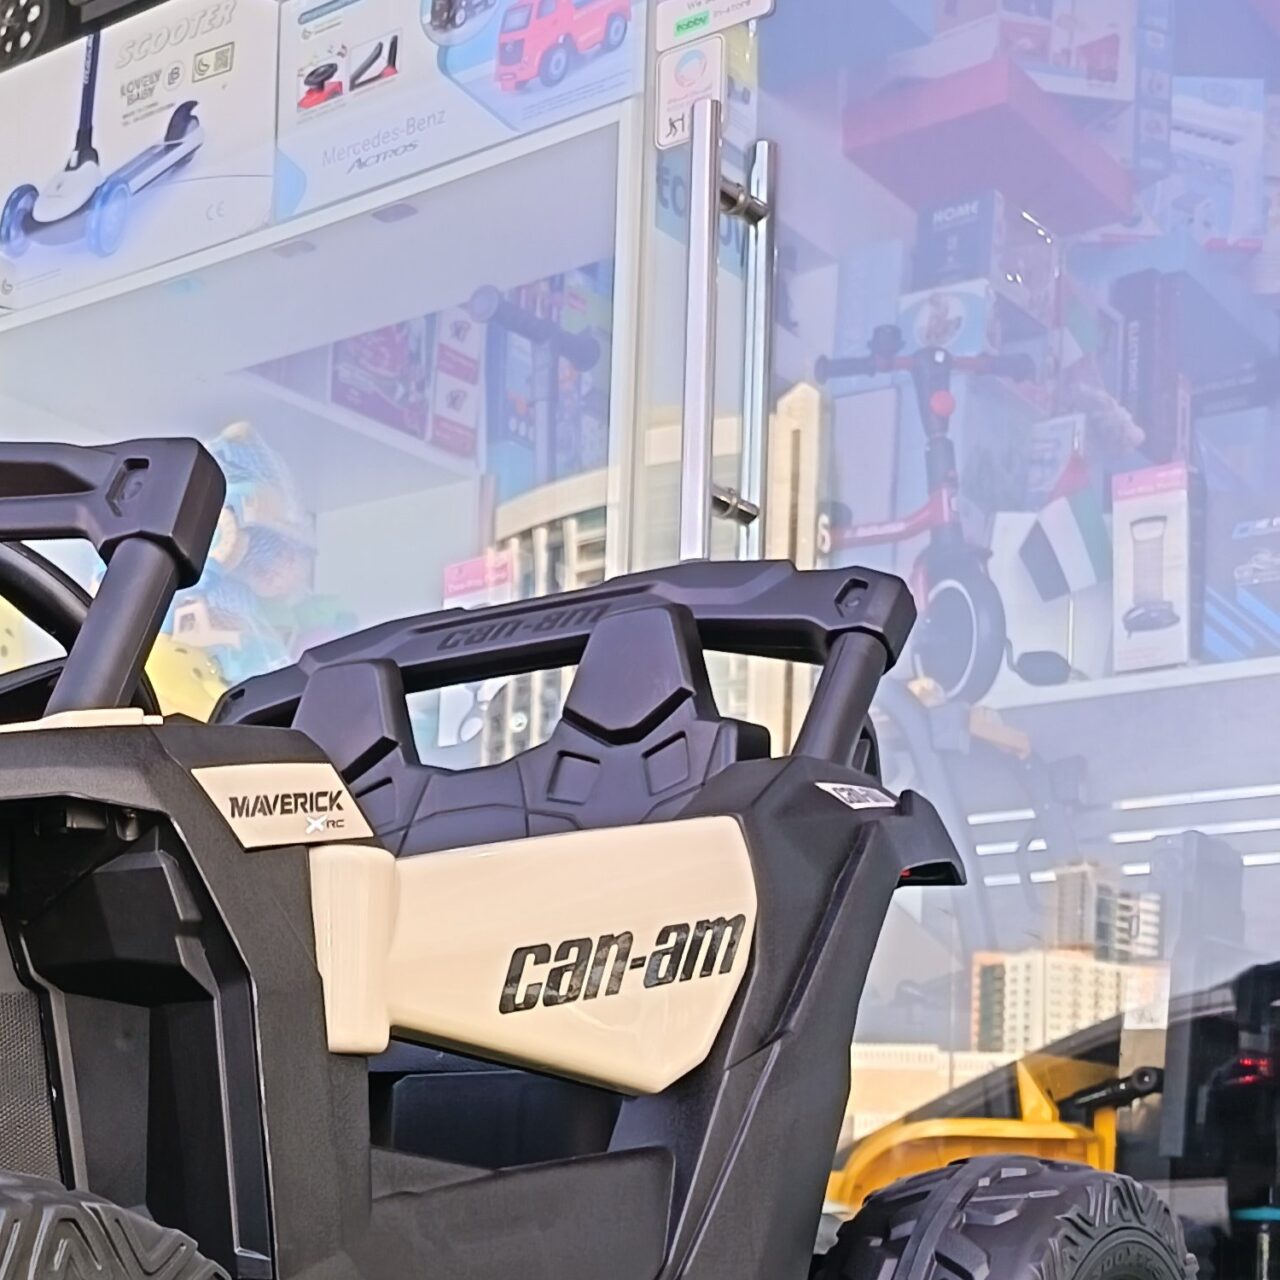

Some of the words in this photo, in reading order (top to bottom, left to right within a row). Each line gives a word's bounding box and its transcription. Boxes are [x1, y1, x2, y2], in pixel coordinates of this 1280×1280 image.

[115, 0, 238, 69] SCOOTER
[120, 69, 162, 97] LOVELY
[126, 85, 156, 106] BABY
[322, 109, 447, 167] Mercedes-Benz
[437, 602, 612, 651] can-am
[228, 789, 345, 819] MAVERICK
[498, 913, 747, 1015] can-am
